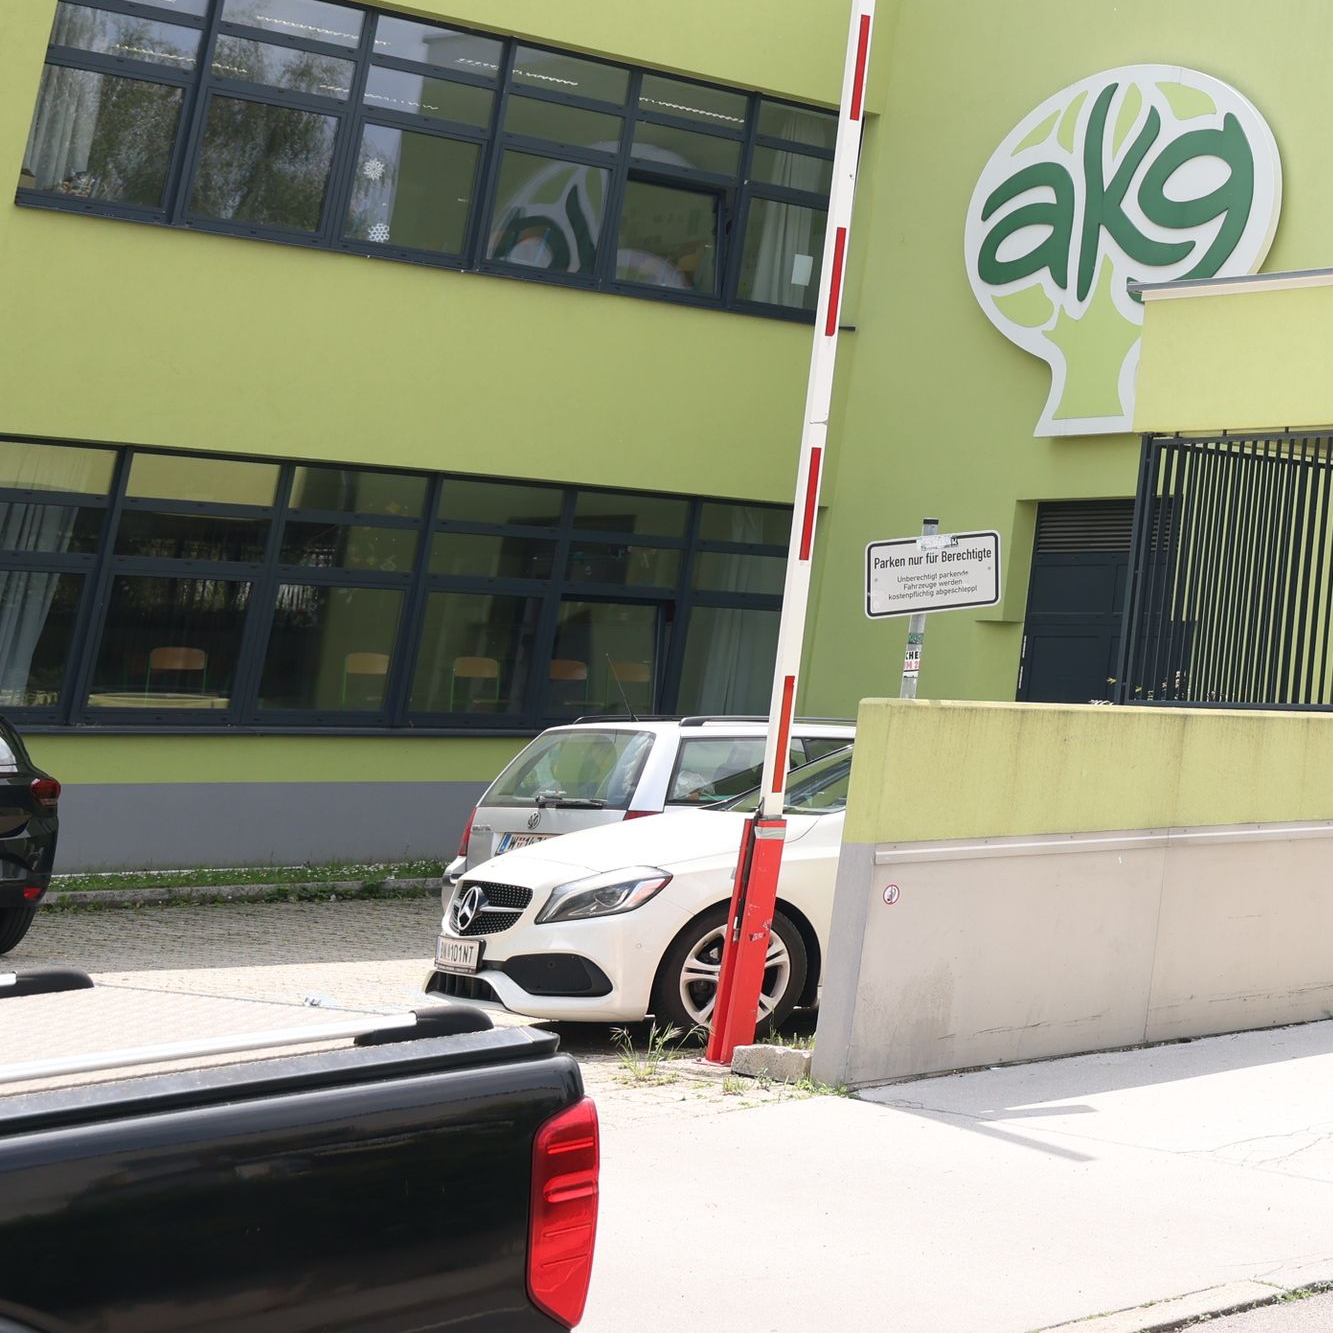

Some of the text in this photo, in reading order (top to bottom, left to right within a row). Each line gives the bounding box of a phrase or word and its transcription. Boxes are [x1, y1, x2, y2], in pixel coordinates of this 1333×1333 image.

[977, 82, 1254, 304] akg
[874, 548, 992, 569] Parken nur für Berechtigte
[897, 573, 938, 583] Unberechtigt
[903, 578, 963, 590] Fahrzeuge werden
[888, 585, 978, 600] kostenpflichtig abgeschleppt
